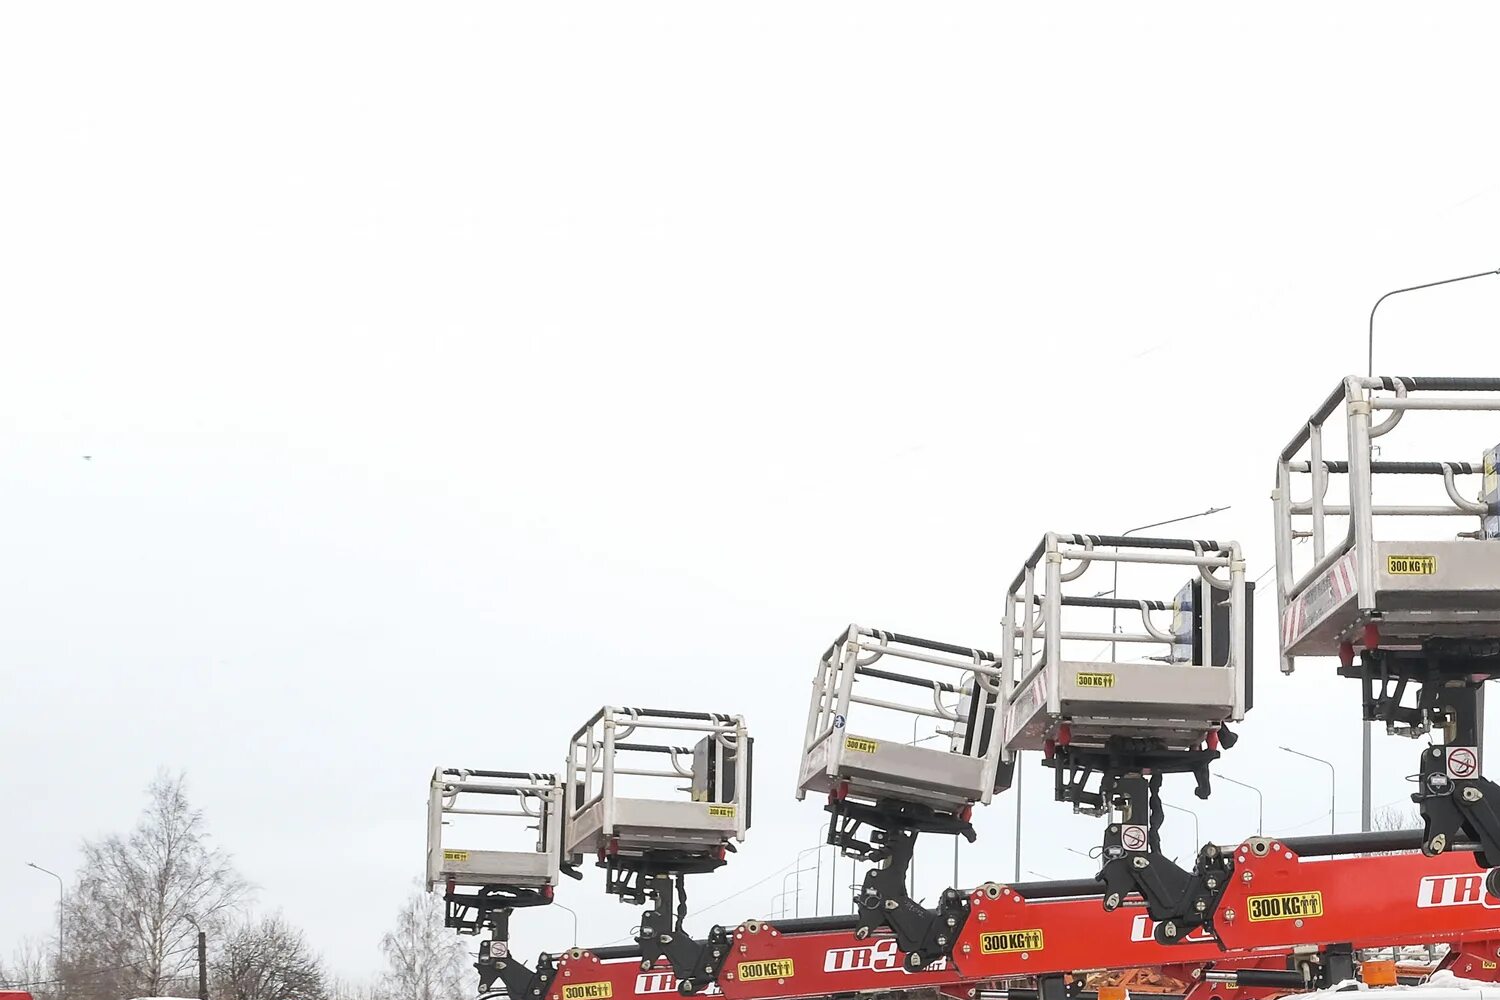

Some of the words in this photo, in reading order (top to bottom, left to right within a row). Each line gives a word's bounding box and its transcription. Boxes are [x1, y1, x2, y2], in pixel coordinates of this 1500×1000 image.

[1390, 560, 1408, 572] 300
[1409, 560, 1421, 572] KG
[1078, 676, 1093, 686] 300
[1093, 676, 1103, 686] KG
[1252, 898, 1281, 918] 300
[1281, 896, 1301, 915] KG
[983, 934, 1008, 951] 300
[1008, 933, 1025, 949] KG
[741, 964, 763, 978] 300
[763, 962, 778, 976] KG
[565, 986, 585, 999] 300
[585, 985, 598, 997] KG
